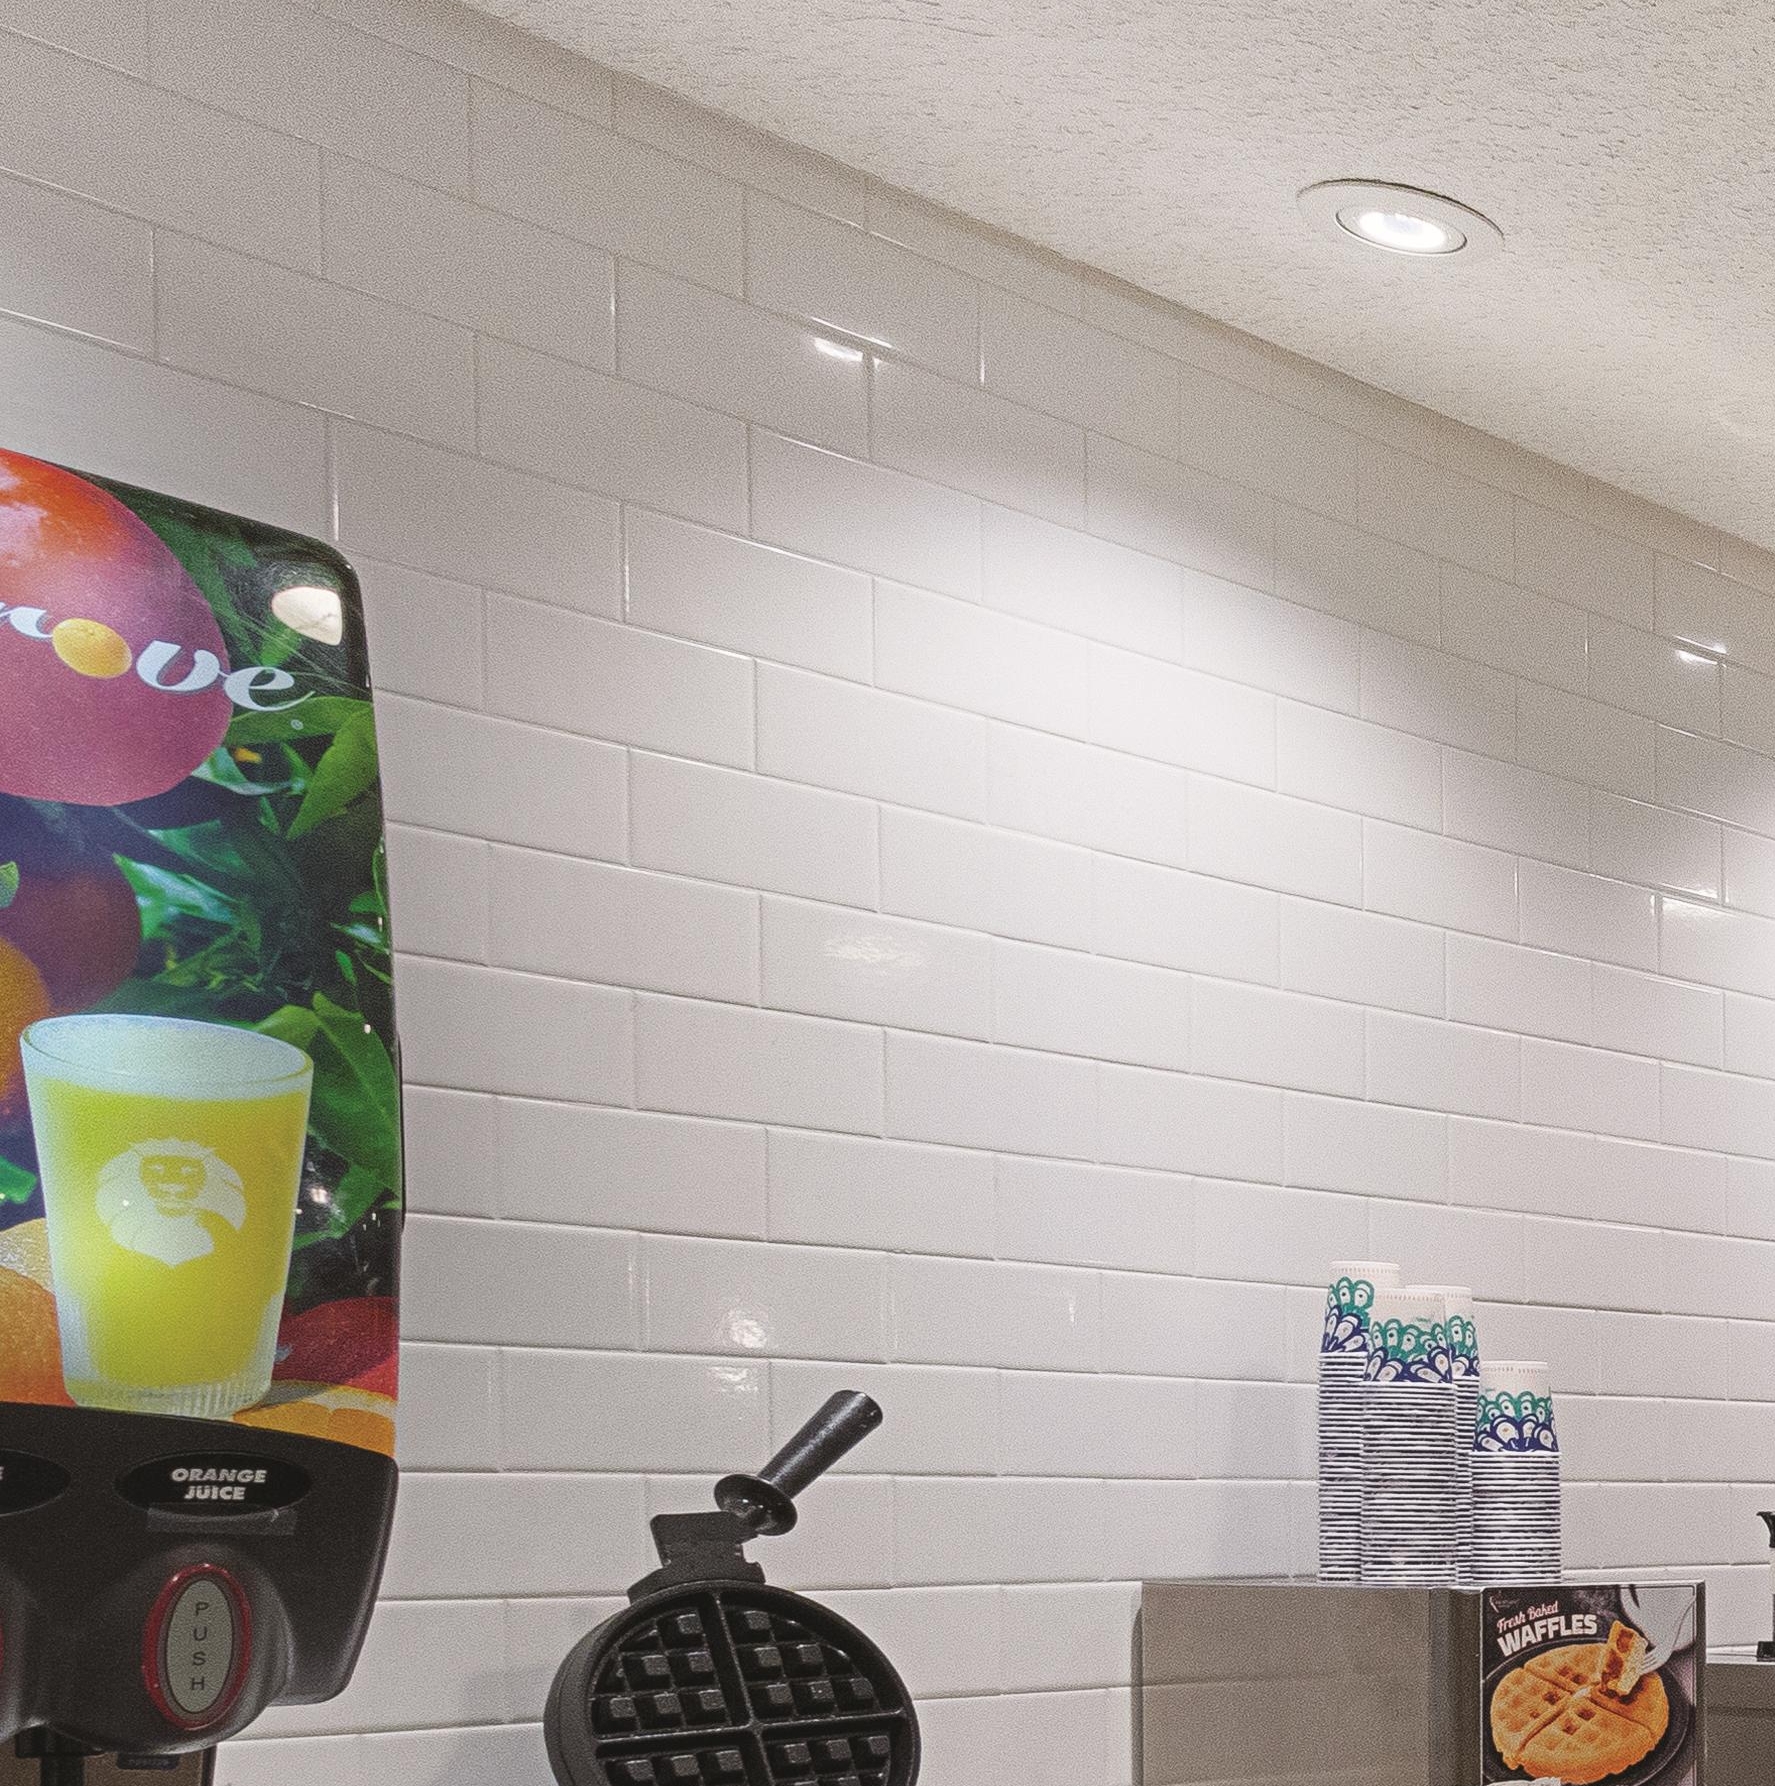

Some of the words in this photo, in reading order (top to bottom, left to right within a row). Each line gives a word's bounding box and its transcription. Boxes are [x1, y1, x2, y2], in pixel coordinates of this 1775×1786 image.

[171, 1468, 268, 1483] ORANGE
[184, 1486, 246, 1500] JUICE
[1496, 1611, 1526, 1633] Fresh
[1527, 1601, 1559, 1619] Baked
[190, 1601, 209, 1691] PUSH
[1497, 1614, 1598, 1657] WAFFLES
